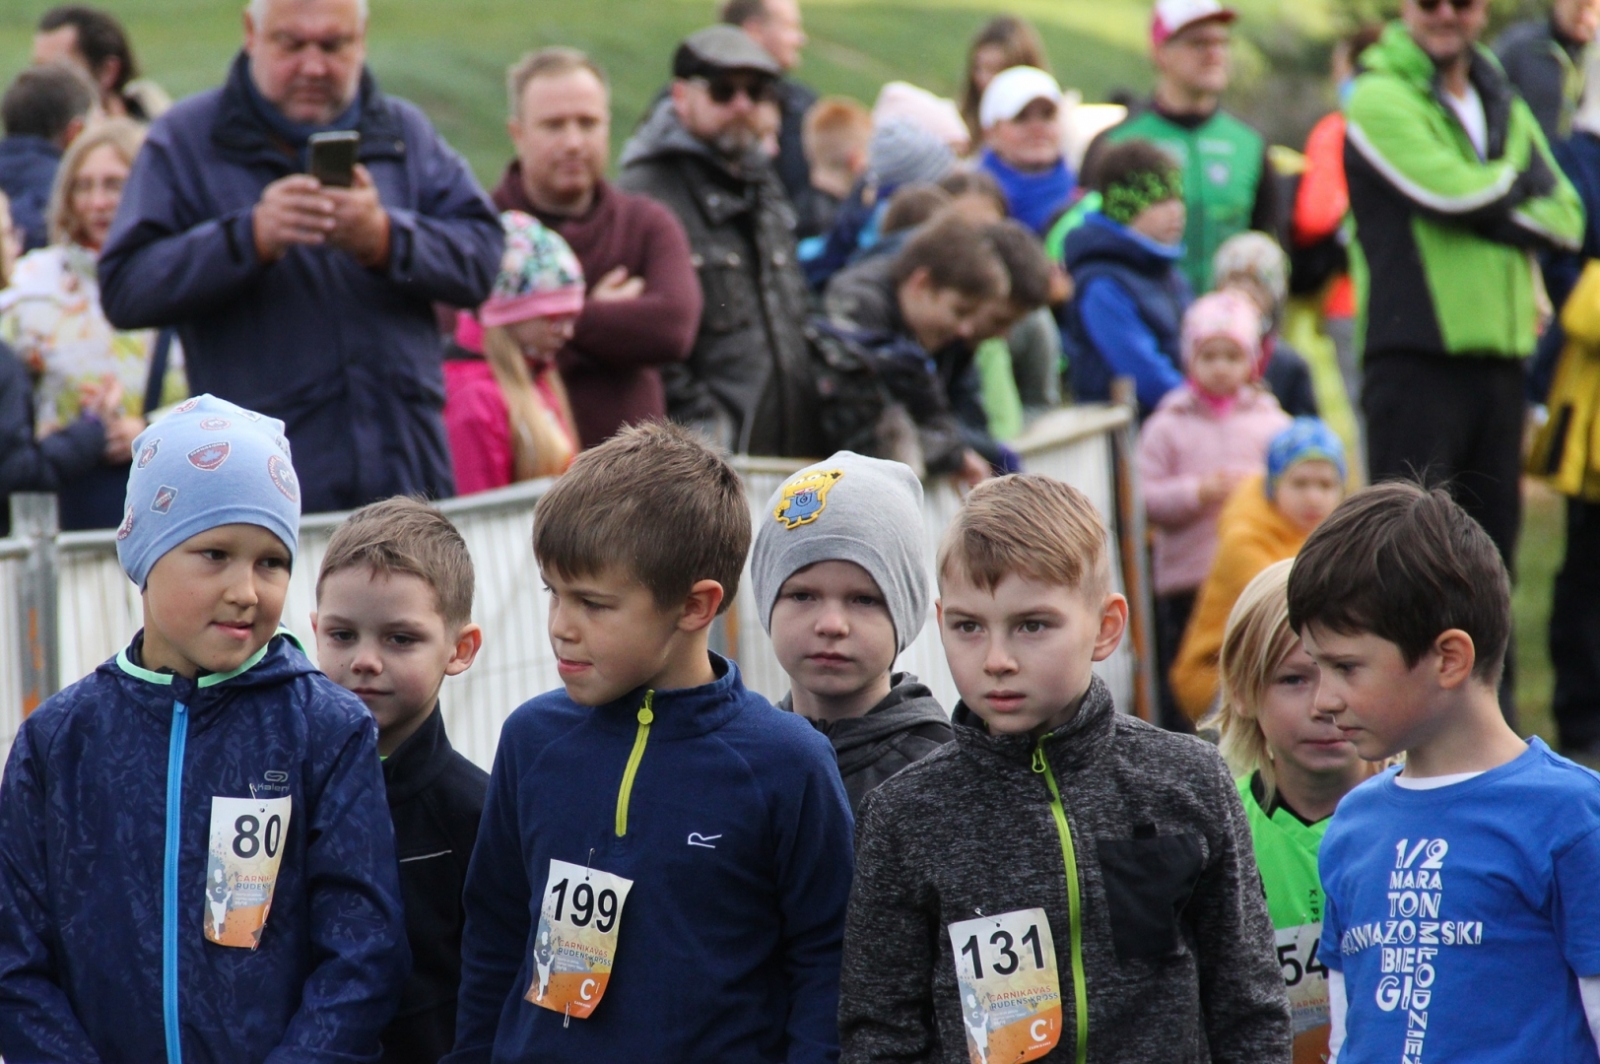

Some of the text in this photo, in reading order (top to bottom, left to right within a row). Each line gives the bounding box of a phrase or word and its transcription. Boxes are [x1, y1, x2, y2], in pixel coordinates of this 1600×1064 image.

[232, 814, 281, 859] 80
[1395, 838, 1449, 869] 1/2
[1389, 870, 1443, 890] MARA
[551, 877, 618, 934] 199
[1387, 890, 1442, 919] TON
[560, 939, 608, 958] CARNIKAVAS
[961, 924, 1045, 980] 131
[990, 985, 1051, 1002] CARNIKAVAS
[990, 997, 1029, 1010] RUDENS
